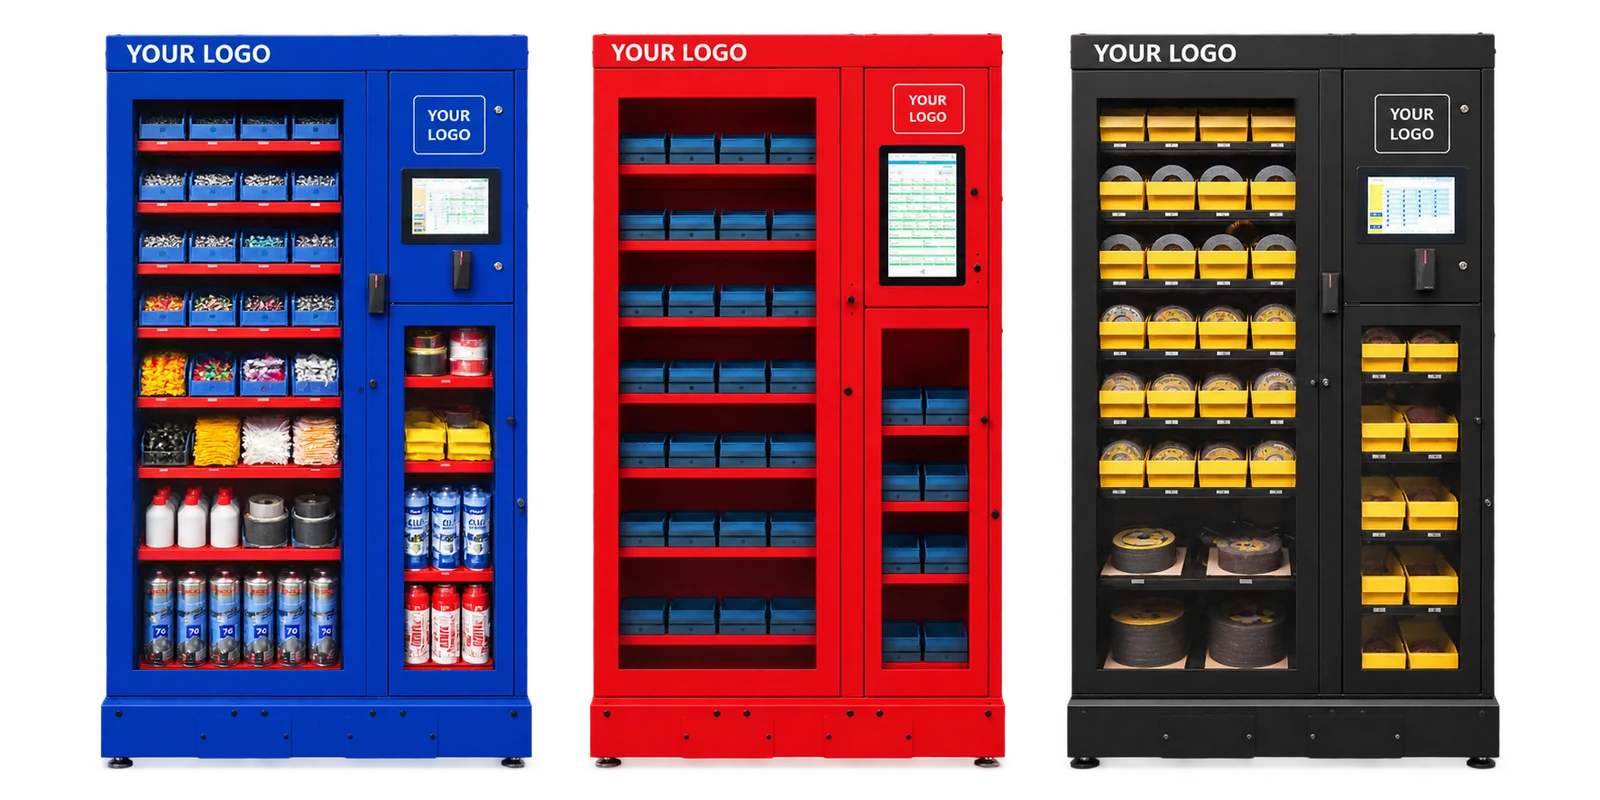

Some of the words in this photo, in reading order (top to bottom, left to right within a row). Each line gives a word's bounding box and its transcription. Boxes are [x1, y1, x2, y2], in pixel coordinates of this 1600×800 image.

[127, 44, 195, 63] YOUR
[204, 44, 271, 63] LOGO
[612, 44, 675, 61] YOUR
[683, 44, 746, 61] LOGO
[1094, 44, 1162, 62] YOUR
[1170, 44, 1236, 62] LOGO
[909, 95, 947, 106] YOUR
[428, 109, 470, 121] YOUR
[909, 111, 947, 123] LOGO
[1390, 108, 1434, 120] YOUR
[428, 128, 471, 141] LOGO
[1390, 128, 1435, 141] LOGO
